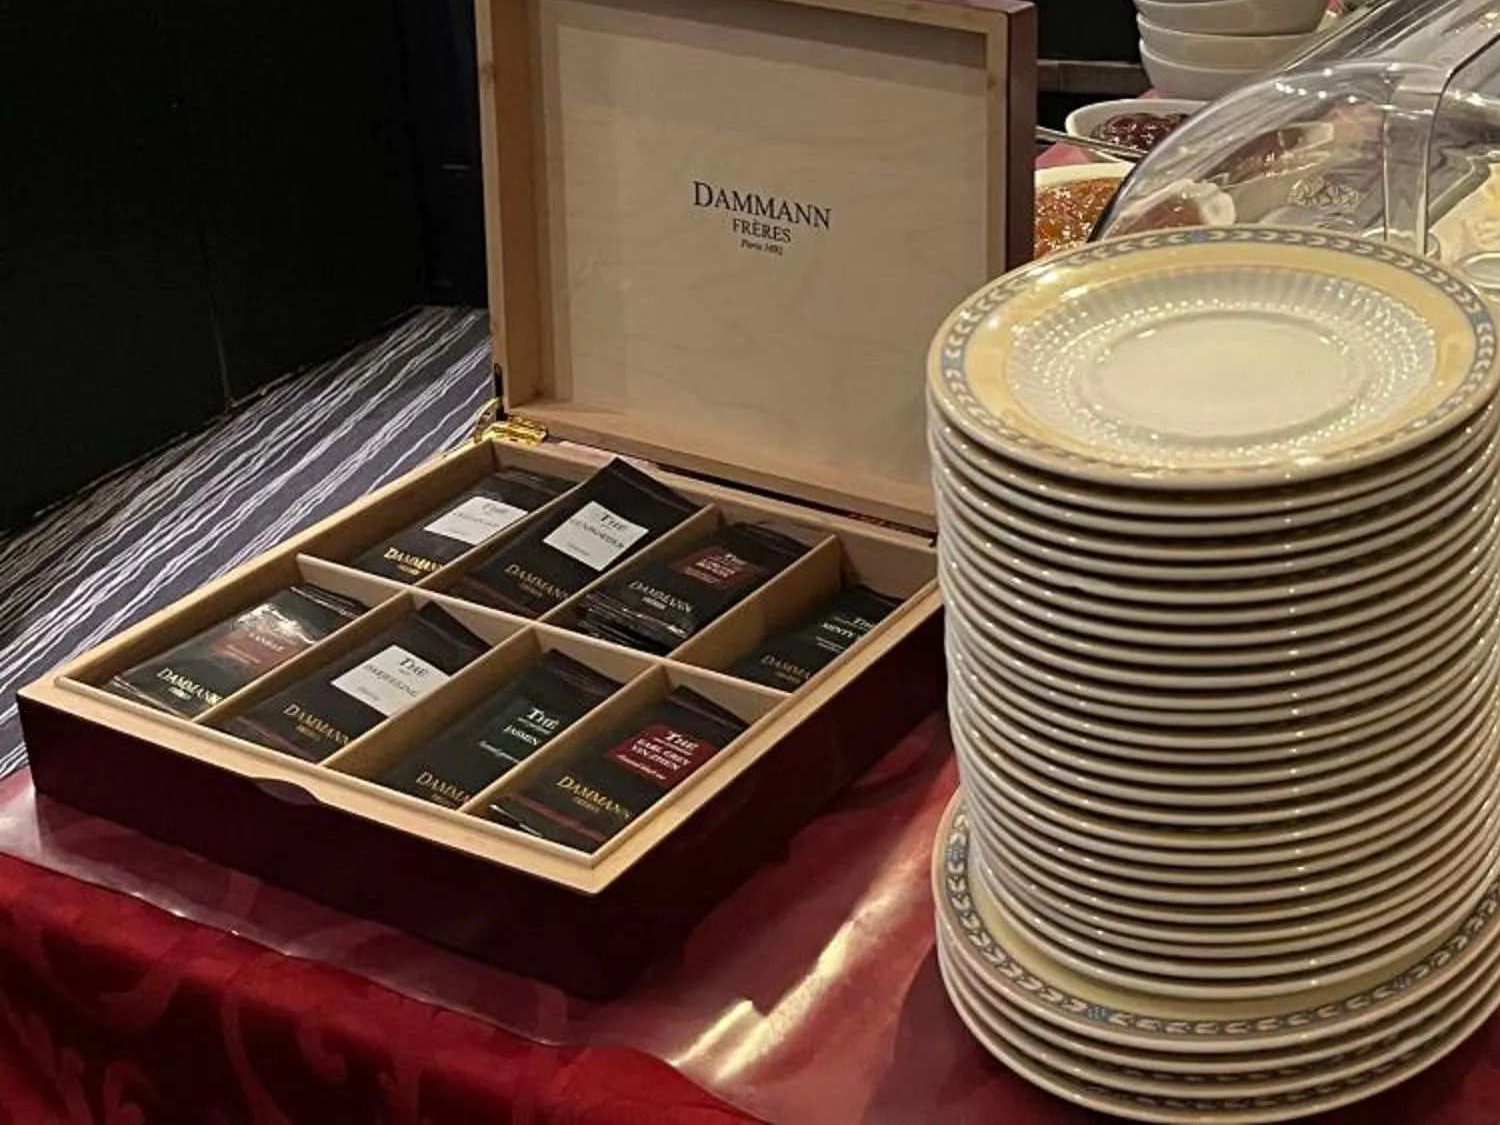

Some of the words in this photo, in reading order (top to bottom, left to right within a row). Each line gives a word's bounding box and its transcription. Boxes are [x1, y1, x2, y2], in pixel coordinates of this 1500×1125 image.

[693, 179, 832, 231] DAMMANN
[732, 217, 792, 244] FRÈRES
[526, 706, 560, 731] THÉ
[503, 724, 540, 746] JASMIN
[665, 729, 700, 752] THÉ
[415, 770, 471, 803] DAMMA
[556, 774, 634, 820] DAMMANN
